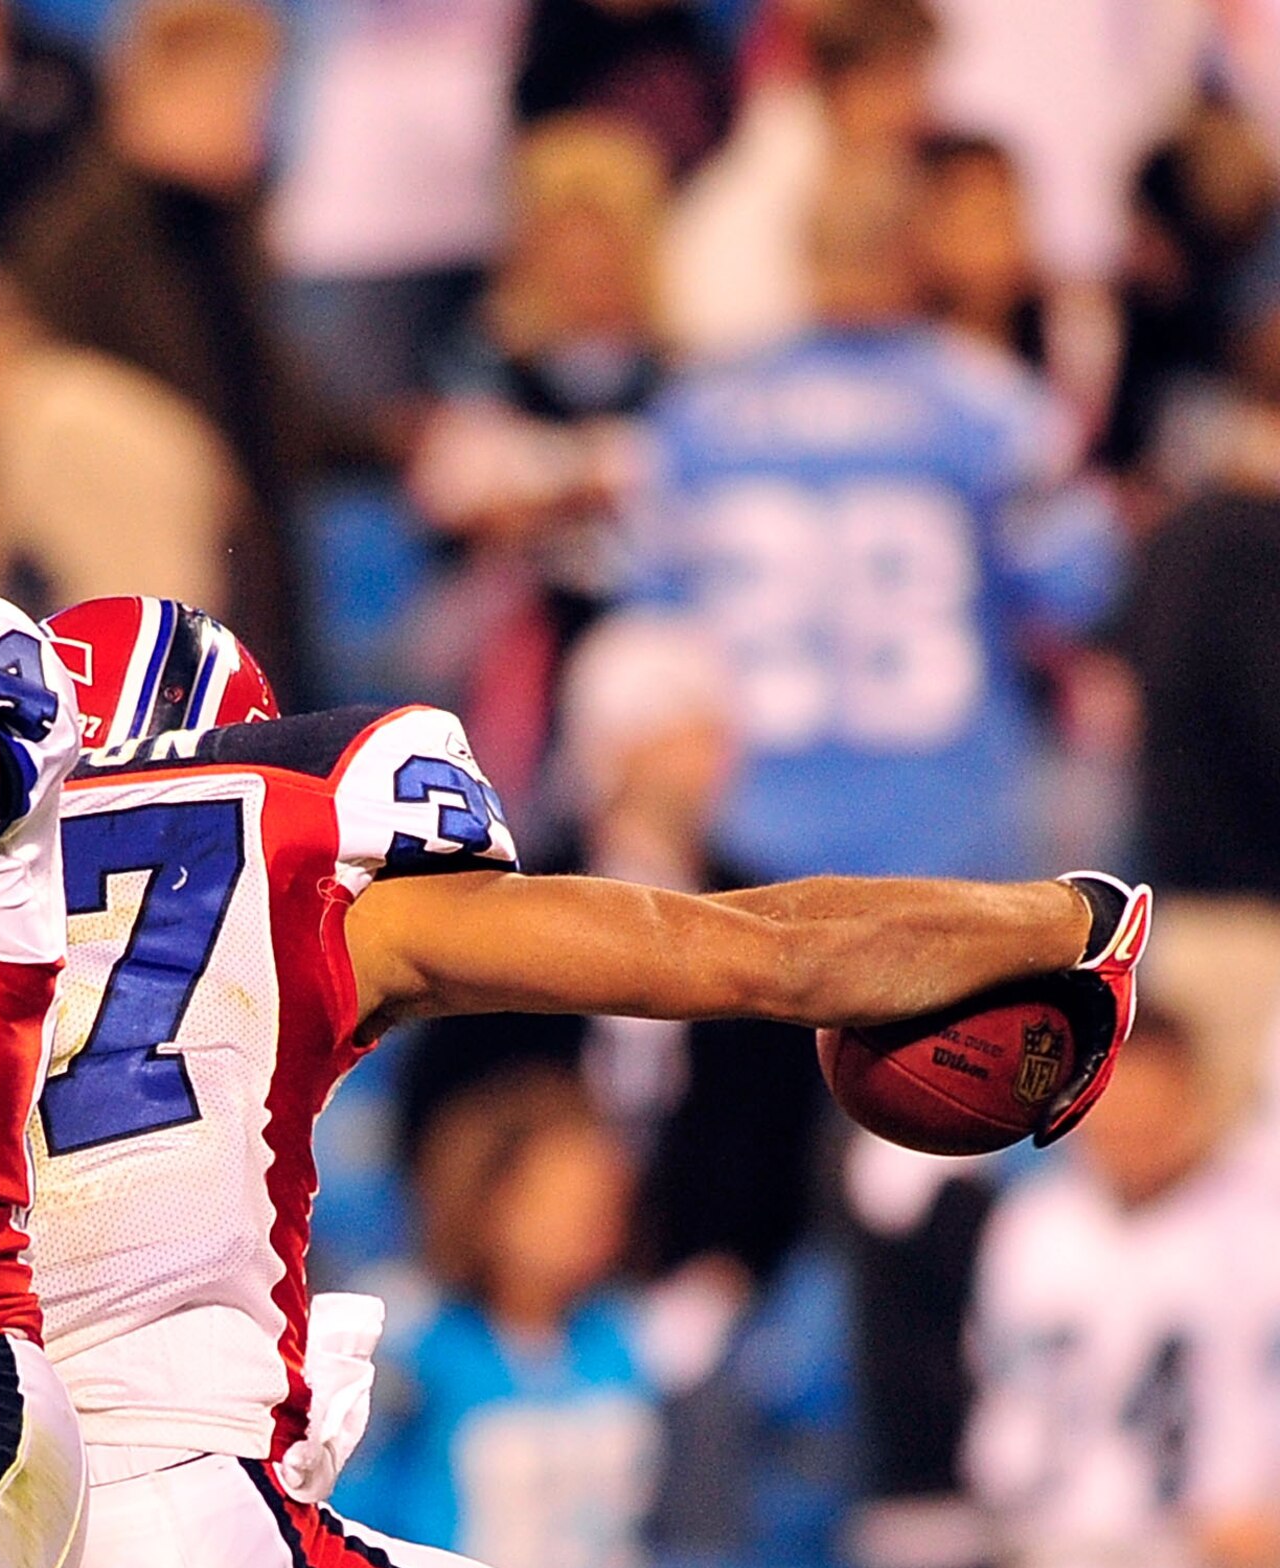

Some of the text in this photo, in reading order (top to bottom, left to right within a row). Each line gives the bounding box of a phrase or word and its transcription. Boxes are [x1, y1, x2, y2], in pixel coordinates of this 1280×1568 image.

[386, 754, 508, 858] 3
[37, 797, 246, 1157] 7
[932, 1046, 989, 1081] Wilson
